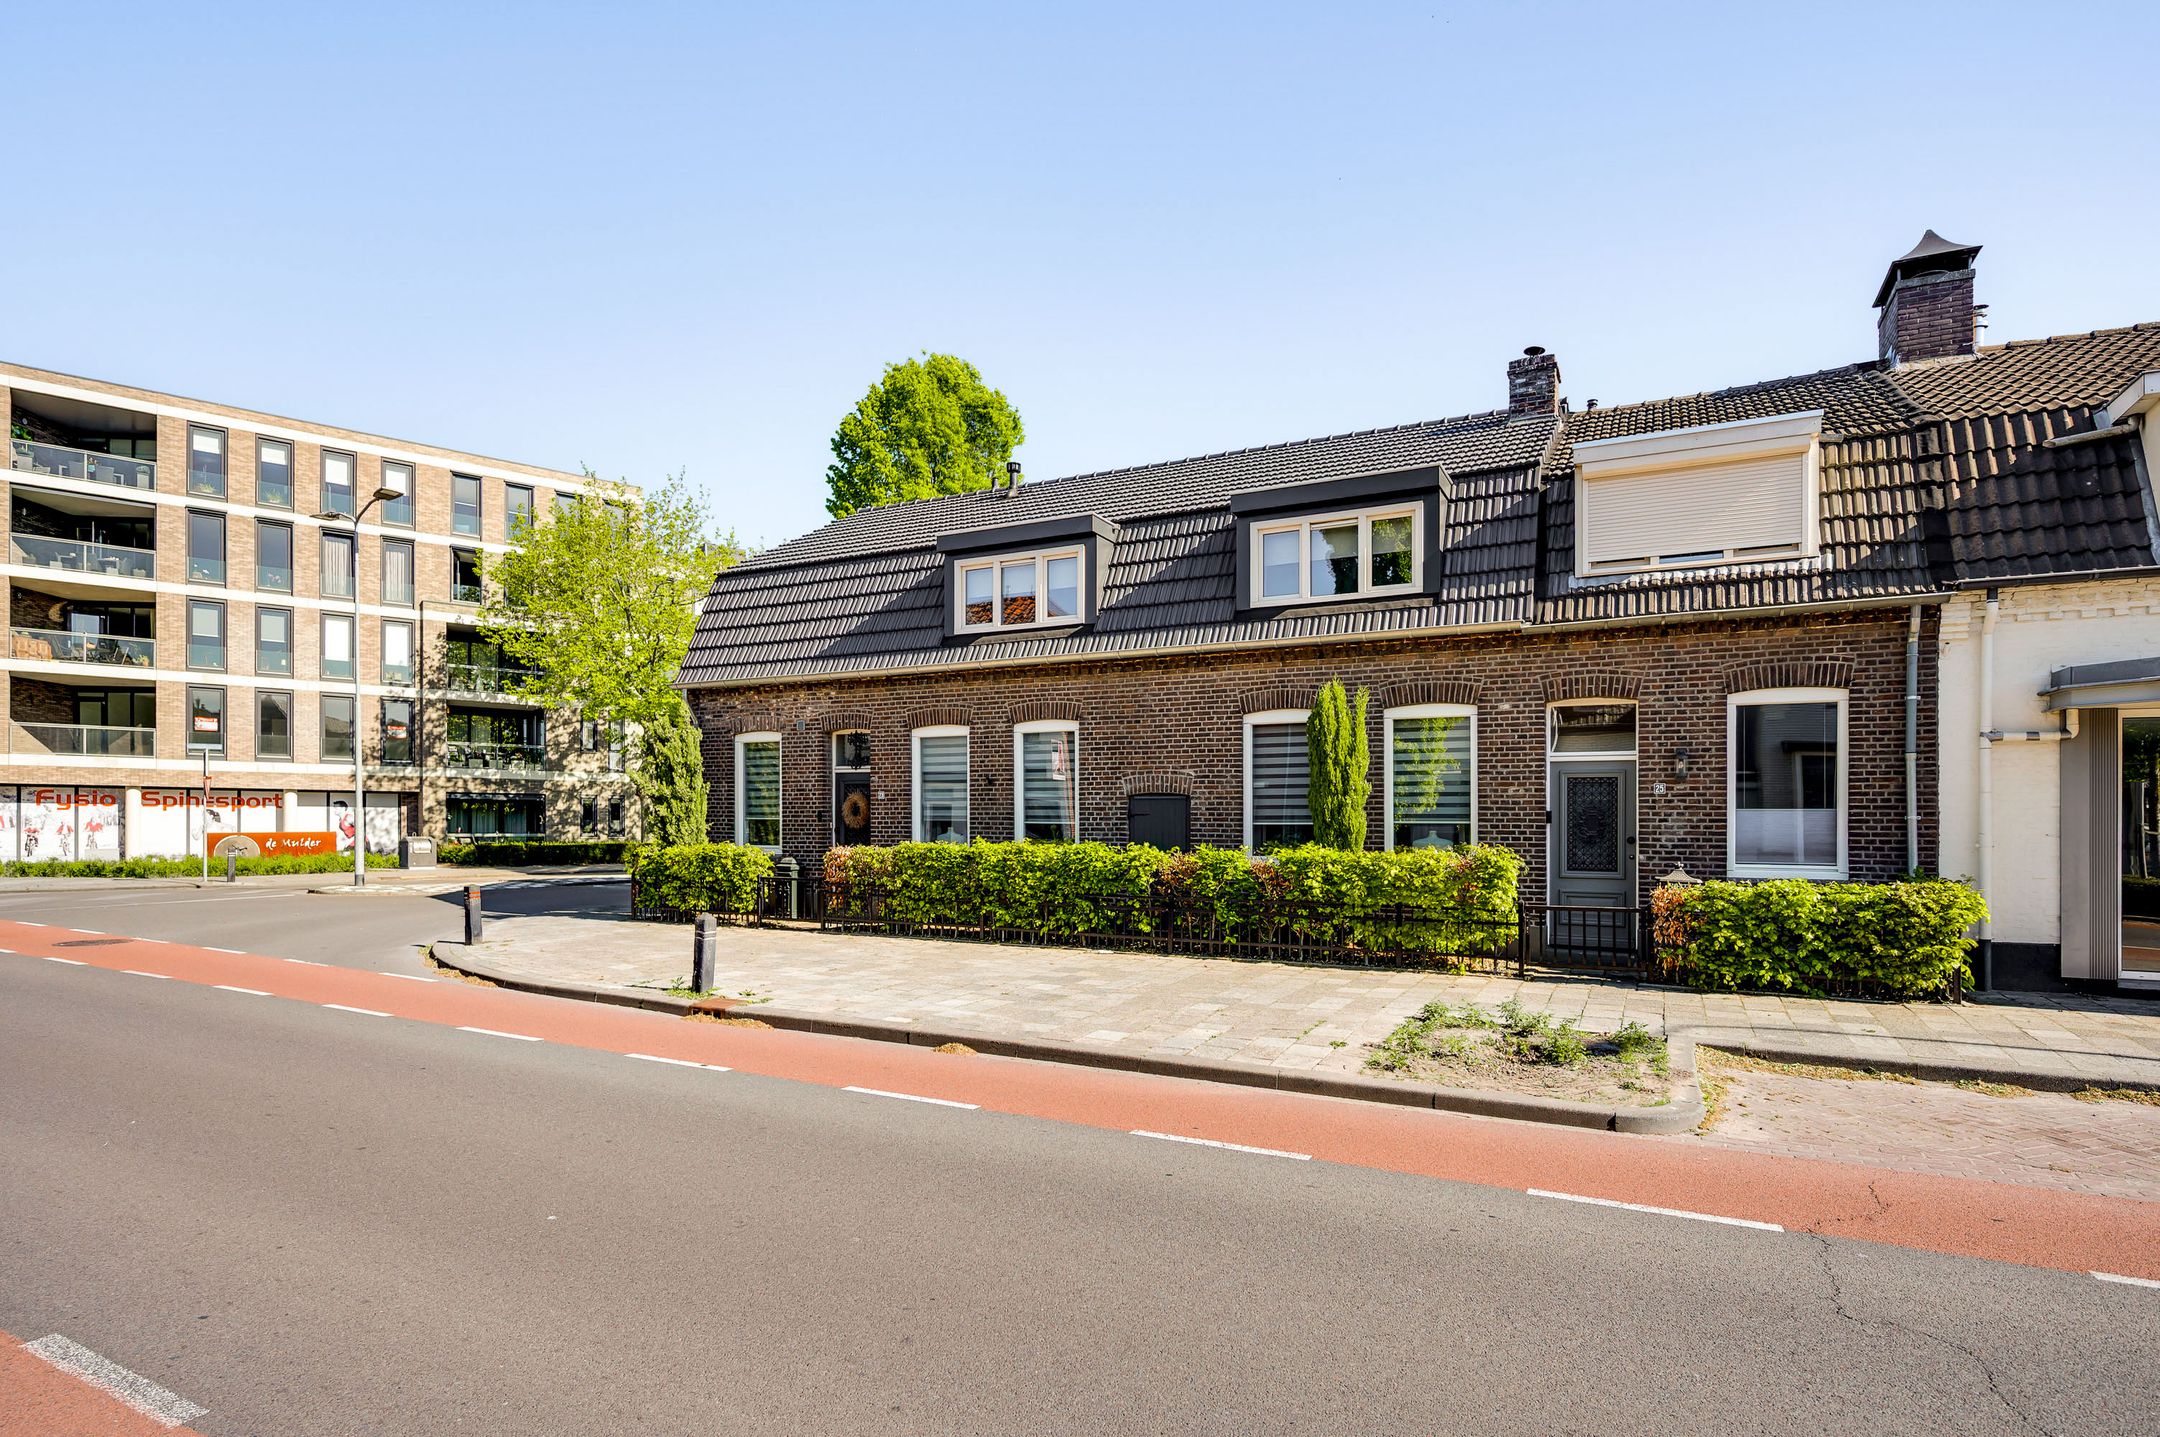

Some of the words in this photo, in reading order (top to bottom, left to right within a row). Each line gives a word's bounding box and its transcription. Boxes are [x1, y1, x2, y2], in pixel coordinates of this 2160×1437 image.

[1655, 784, 1665, 793] 25
[36, 788, 116, 810] Fysio
[265, 838, 277, 850] de
[281, 837, 321, 849] Mulder
